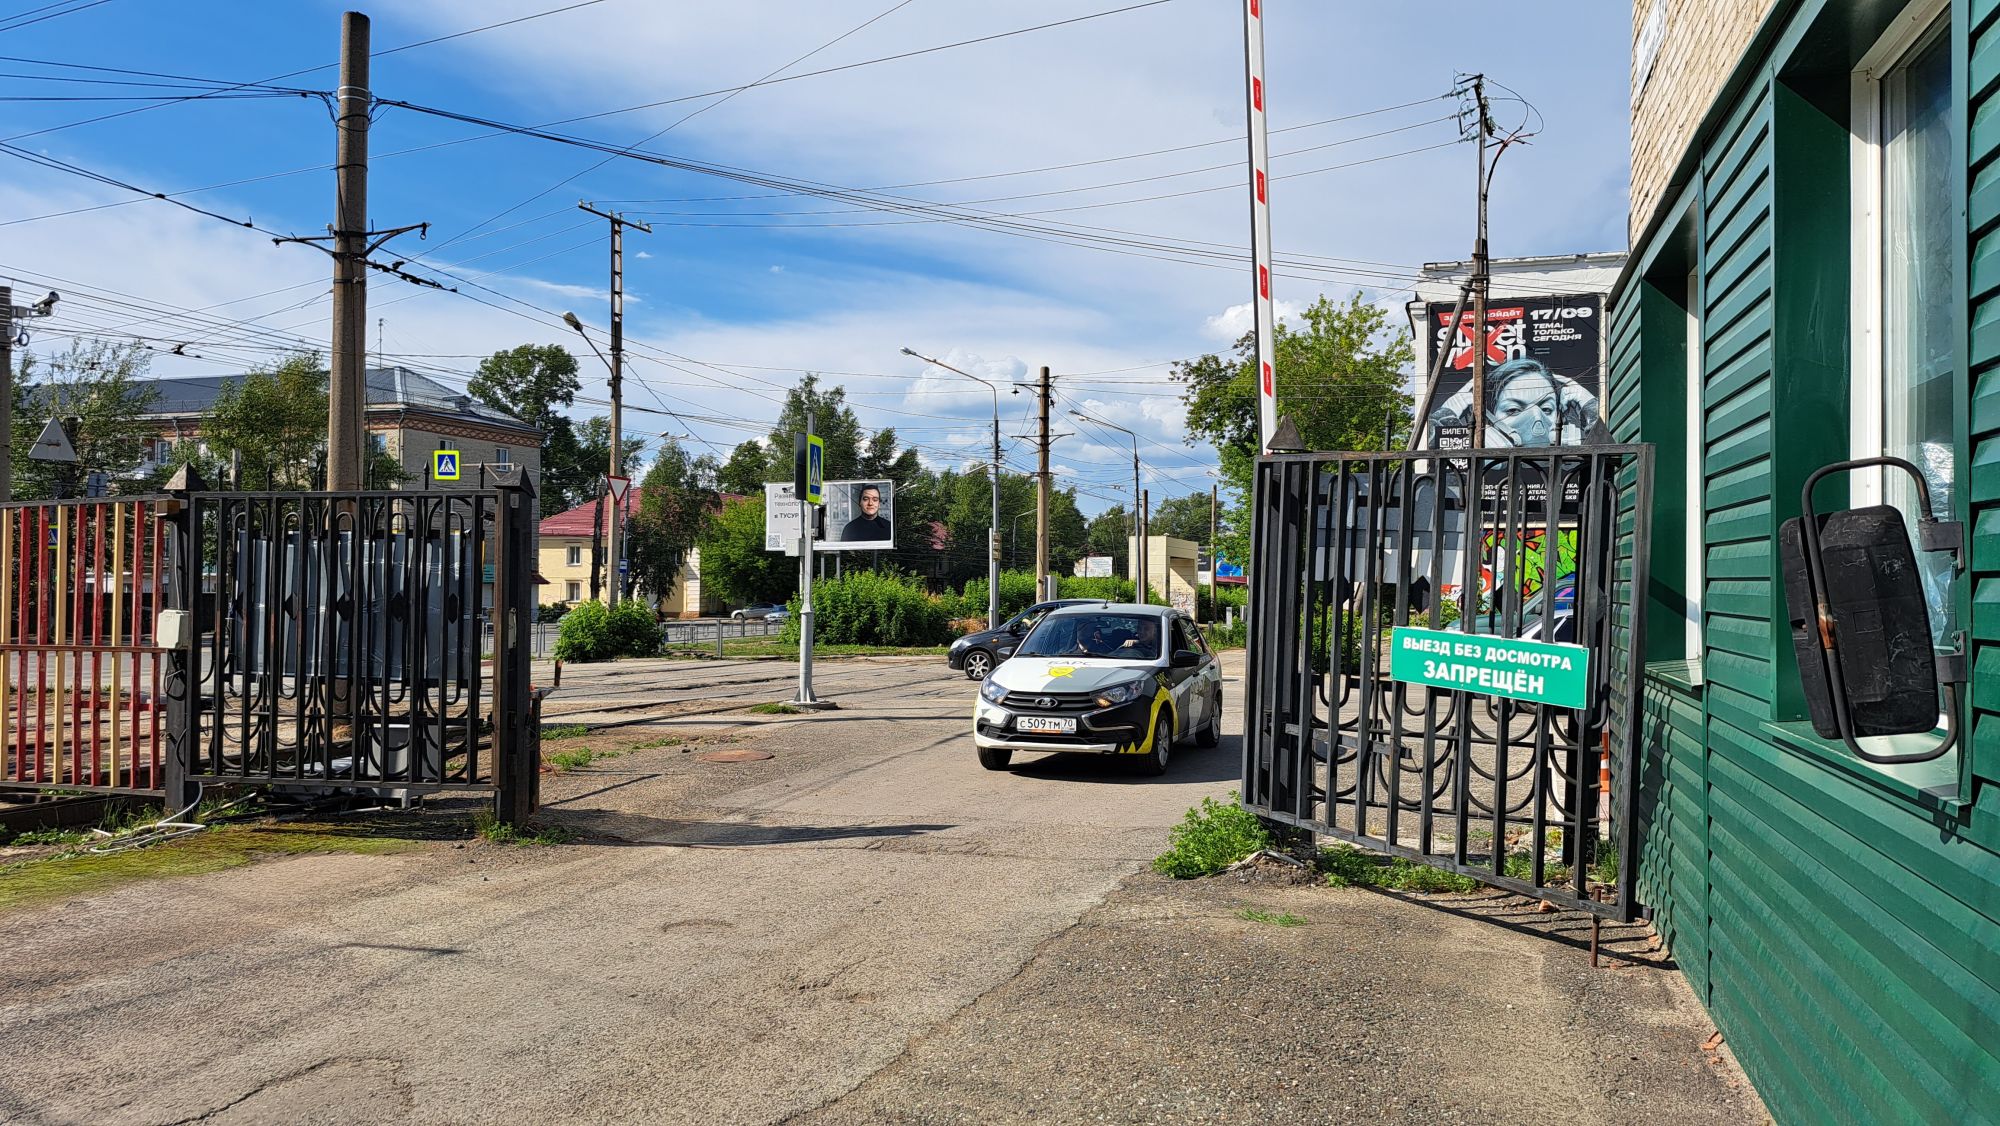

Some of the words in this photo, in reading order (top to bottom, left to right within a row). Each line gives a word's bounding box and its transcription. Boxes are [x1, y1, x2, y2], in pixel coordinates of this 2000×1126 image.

[1530, 307, 1592, 320] 17/09
[1532, 334, 1582, 342] СЕГОДНЯ
[1403, 636, 1451, 656] ВЫЕЗД
[1454, 643, 1482, 658] БЕЗ
[1485, 647, 1573, 671] ДОСМОТРА
[1423, 660, 1545, 695] ЗАПРЕЩЁН
